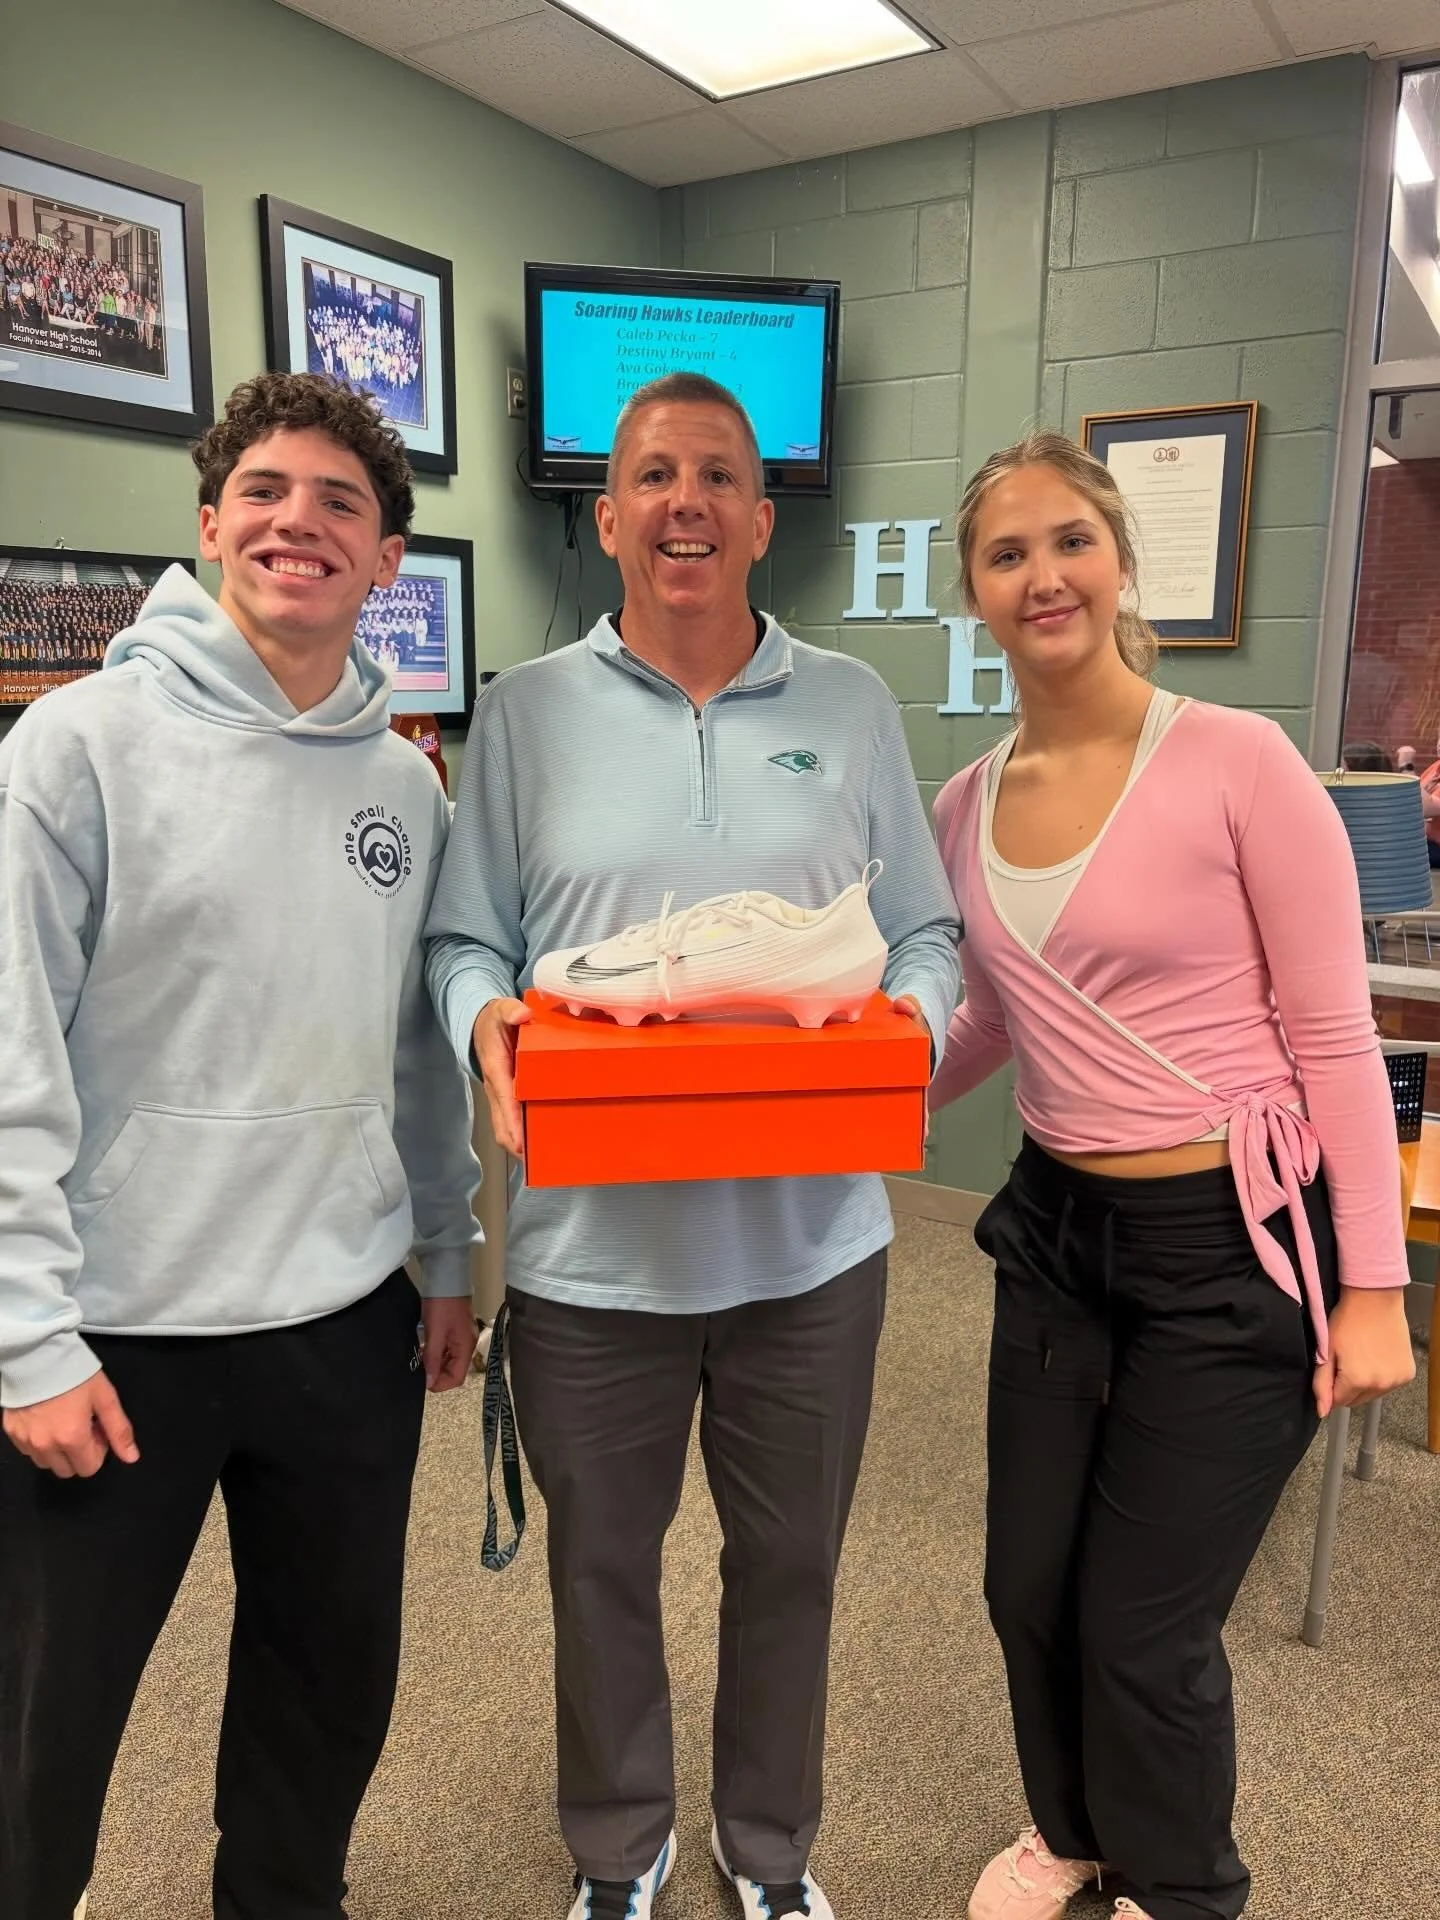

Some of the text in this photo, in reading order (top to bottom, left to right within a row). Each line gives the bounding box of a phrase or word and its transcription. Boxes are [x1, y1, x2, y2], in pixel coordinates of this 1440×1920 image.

[575, 300, 795, 329] Soaring Hawks Leaderboard
[9, 332, 102, 358] Faculty and Staff 2015-2016
[12, 322, 97, 348] Hanover High School
[616, 327, 653, 341] Caleb
[710, 332, 719, 344] 7
[616, 344, 667, 359] Destiny
[671, 347, 716, 361] Bryant
[729, 350, 737, 361] 4
[616, 361, 641, 374] Ava
[842, 519, 941, 618] H
[937, 617, 1015, 714] H
[3, 684, 40, 693] Hanover
[345, 804, 412, 876] one small chance
[501, 1392, 518, 1463] HANOV
